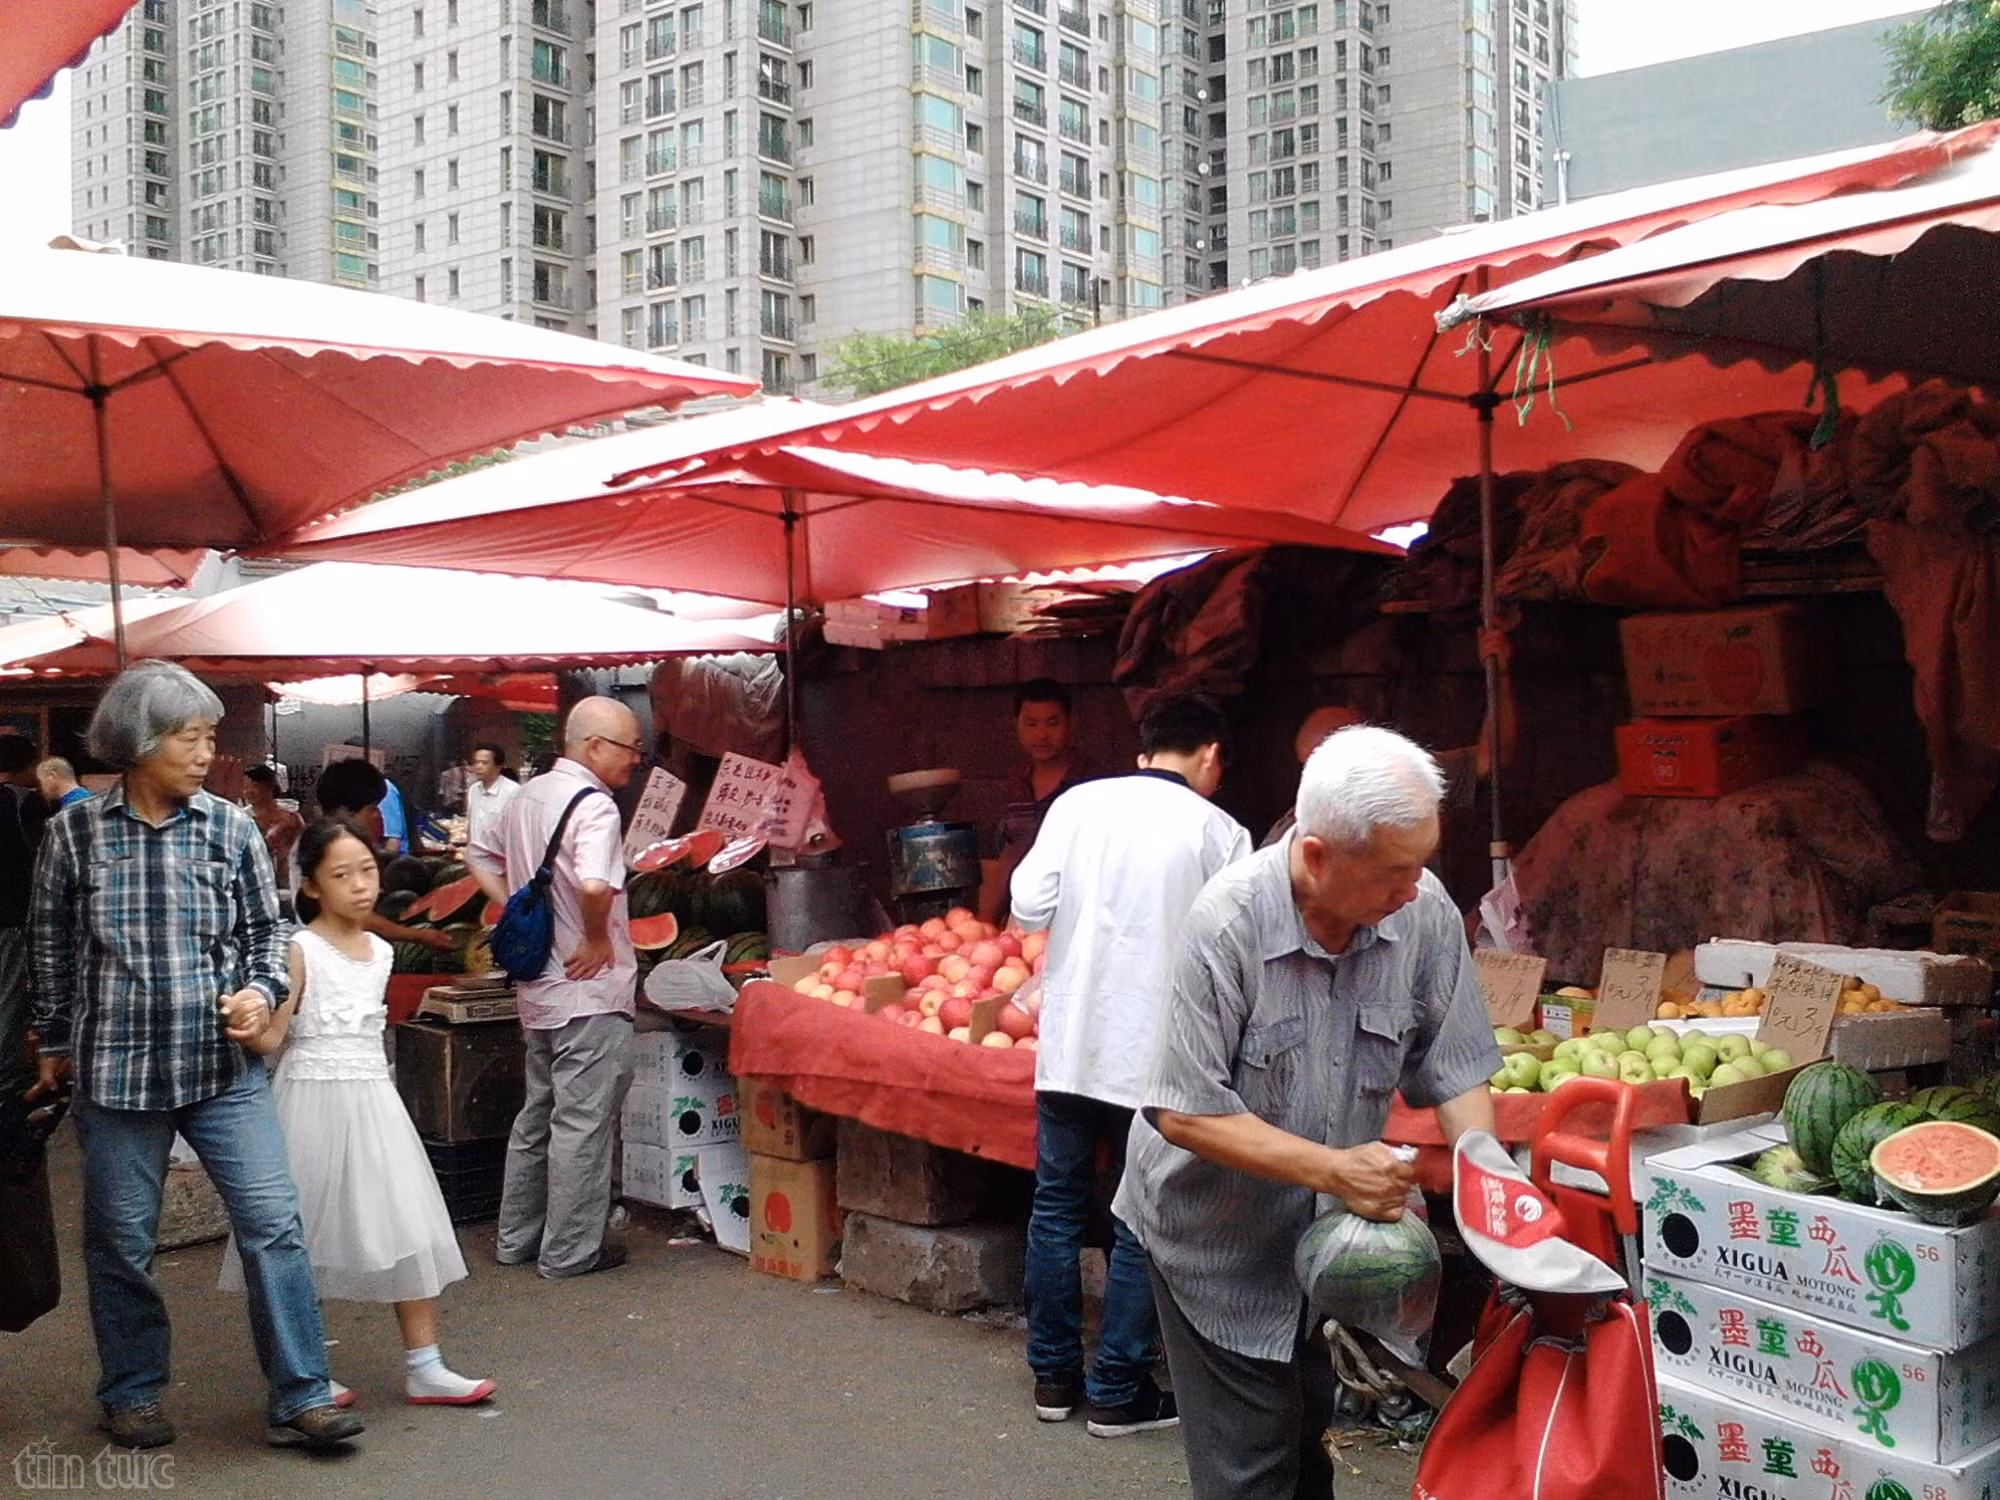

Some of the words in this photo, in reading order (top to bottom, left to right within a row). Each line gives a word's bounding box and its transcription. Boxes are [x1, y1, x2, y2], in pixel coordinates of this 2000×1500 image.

[711, 1117, 740, 1130] XIGU
[1728, 1200, 1862, 1286] 墨童西瓜
[1915, 1243, 1940, 1262] 56
[1716, 1245, 1789, 1281] XIGUA
[1796, 1274, 1857, 1301] MOTONG
[1719, 1308, 1849, 1400] 墨童西瓜
[1709, 1345, 1778, 1385] XIGUA
[1785, 1379, 1843, 1409] MOTONG
[1902, 1363, 1926, 1382] 56
[1719, 1474, 1787, 1500] XIG
[1923, 1484, 1947, 1500] 58
